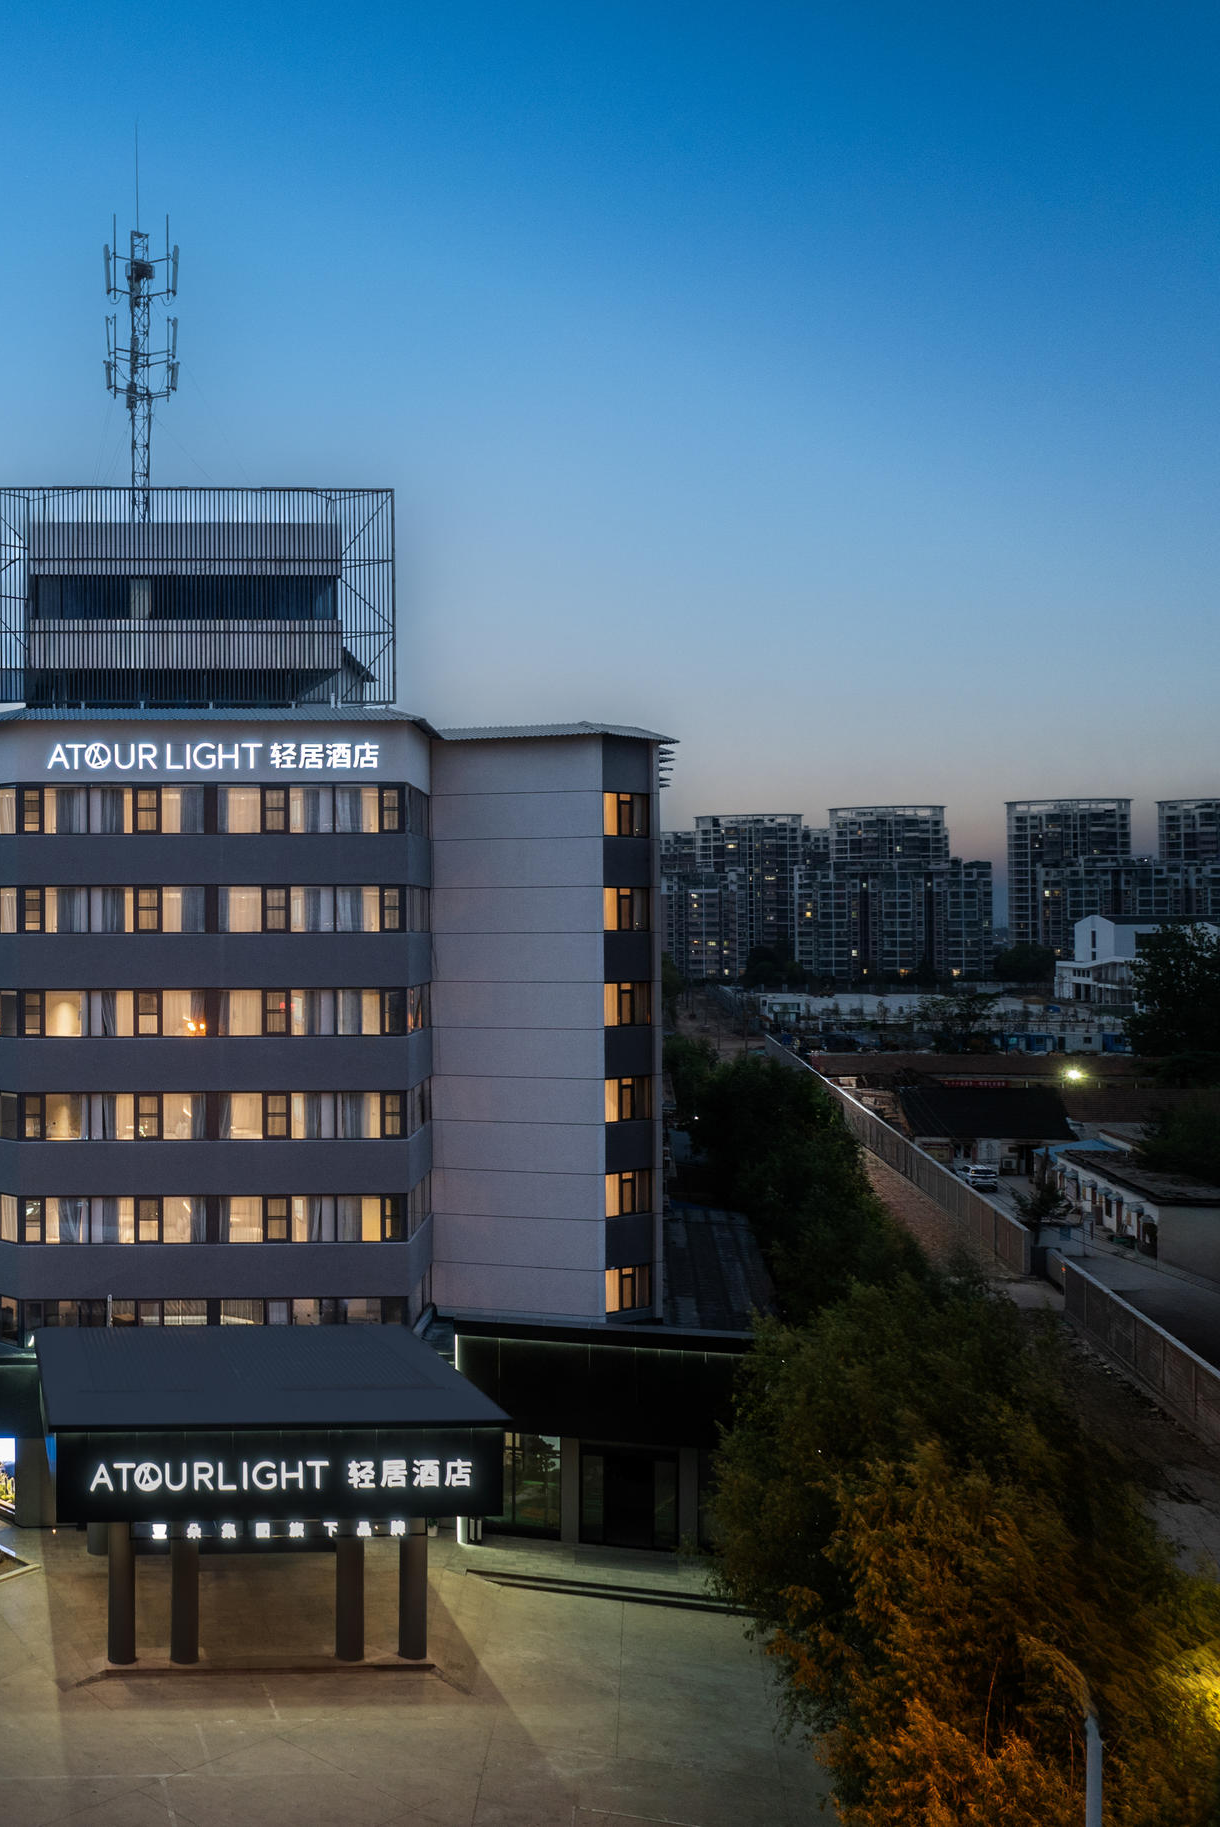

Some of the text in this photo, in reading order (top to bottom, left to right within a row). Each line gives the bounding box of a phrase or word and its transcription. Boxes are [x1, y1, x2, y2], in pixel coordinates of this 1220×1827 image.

[46, 741, 380, 770] ATOUR LIGHT 轻居酒店
[347, 1458, 473, 1489] 轻居酒店
